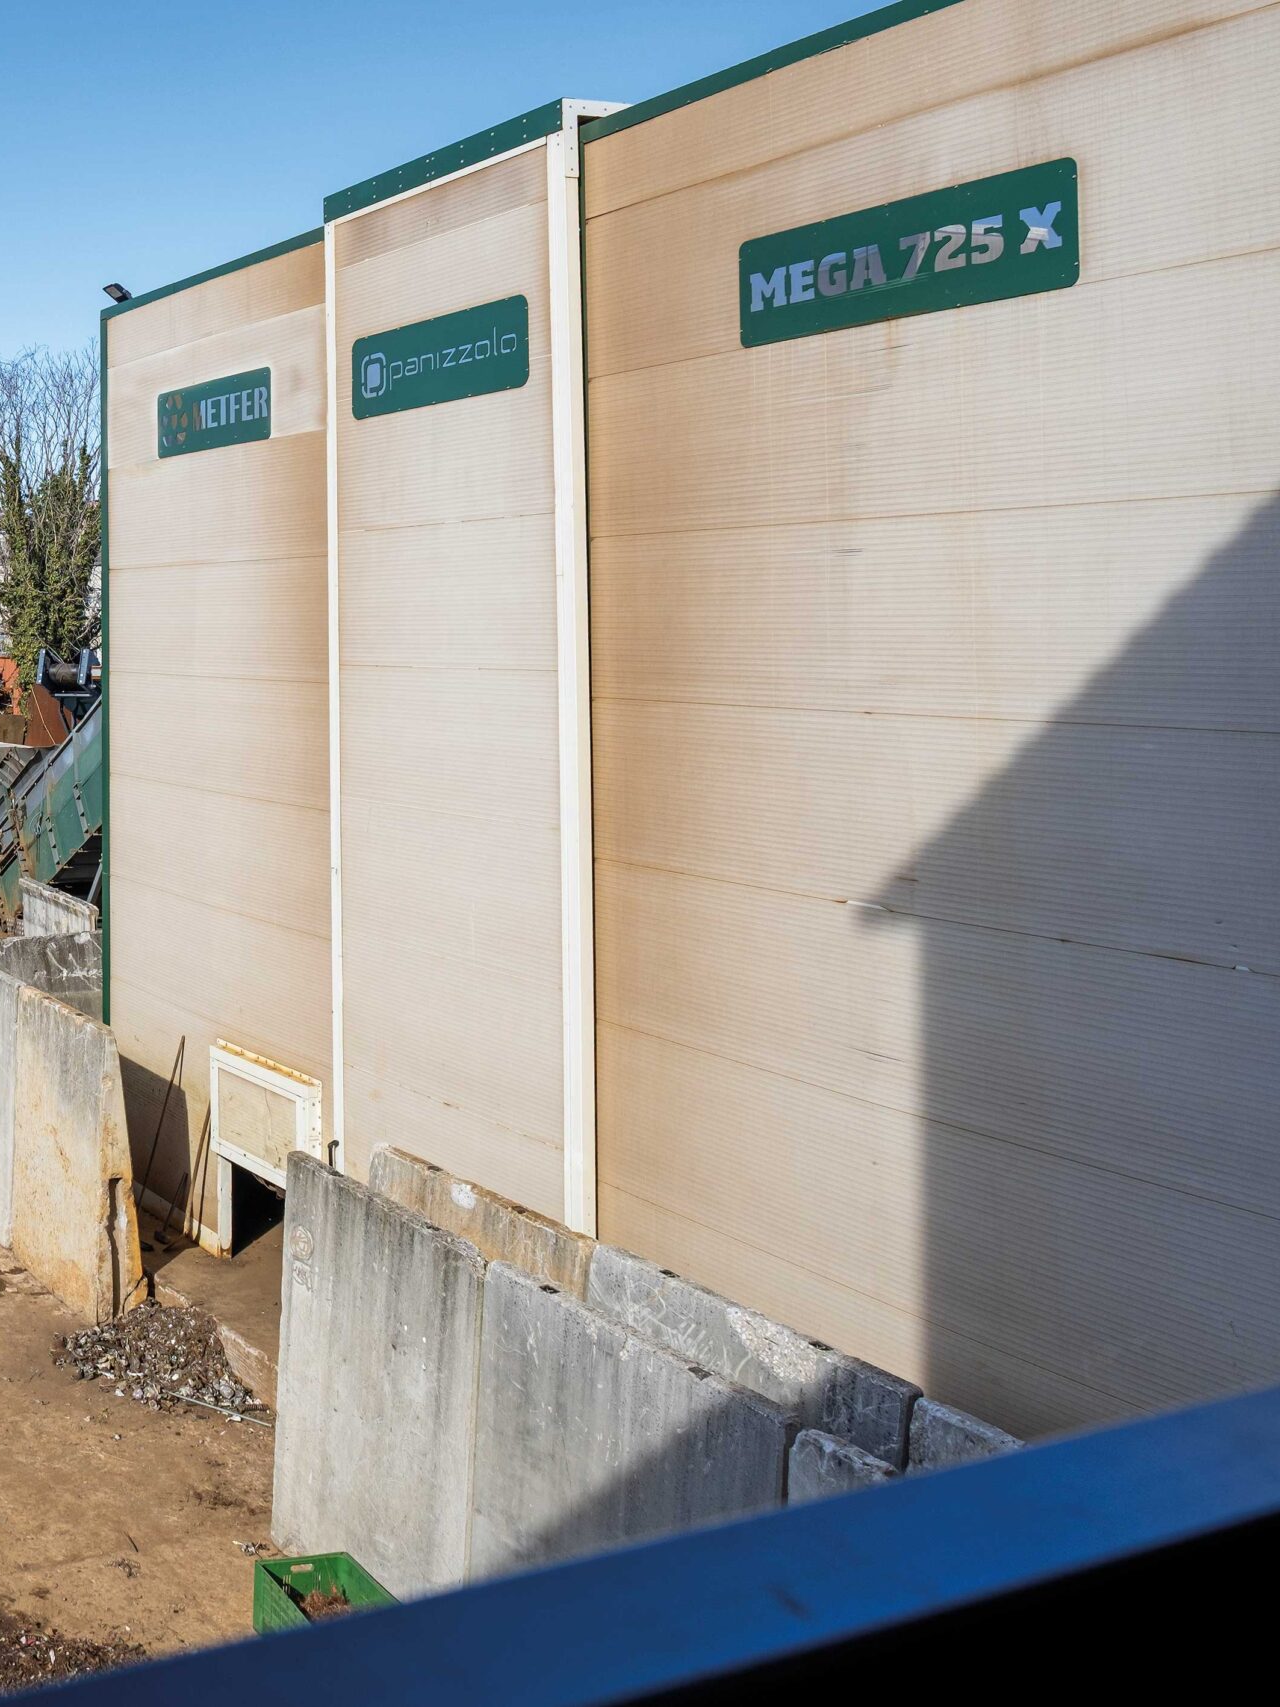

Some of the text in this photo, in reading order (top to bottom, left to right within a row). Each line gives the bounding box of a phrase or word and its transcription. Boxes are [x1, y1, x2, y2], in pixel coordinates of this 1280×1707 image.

[749, 200, 1063, 313] MEGA 725 X
[389, 326, 517, 391] panizzolo
[192, 386, 269, 432] METFER
